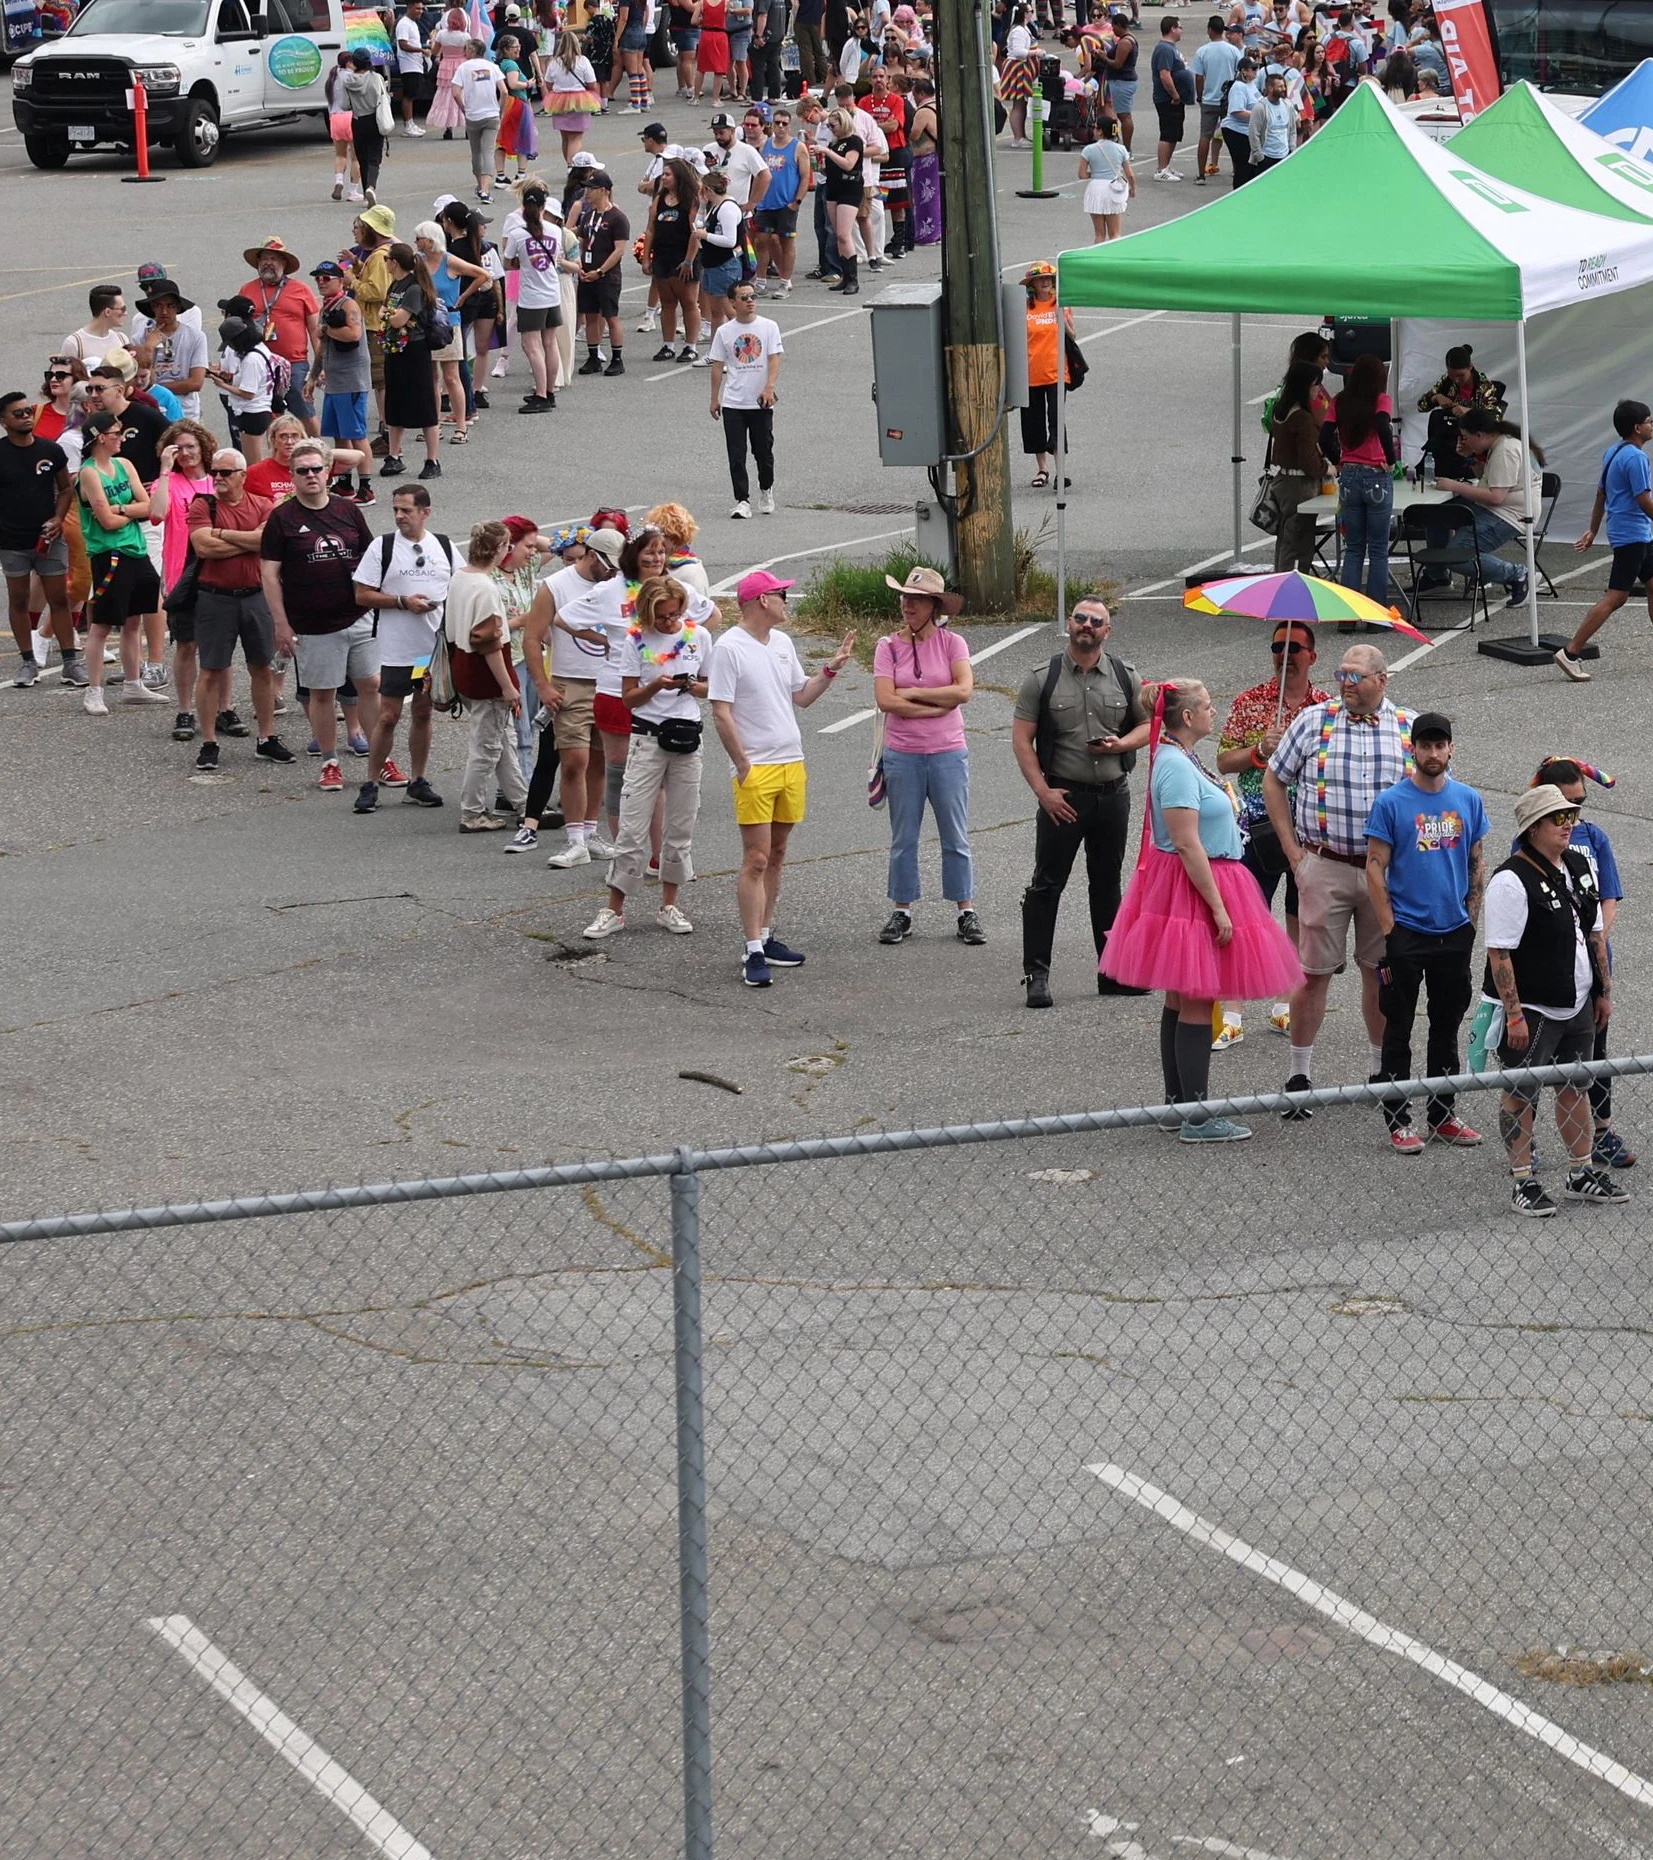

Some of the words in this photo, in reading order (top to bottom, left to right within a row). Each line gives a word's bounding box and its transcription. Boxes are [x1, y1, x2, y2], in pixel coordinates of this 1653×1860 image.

[1578, 259, 1588, 273] TD
[1587, 254, 1608, 270] READY
[1577, 266, 1620, 290] COMMITMENT
[399, 569, 436, 577] MOSAIC
[1424, 822, 1455, 834] PRIDE
